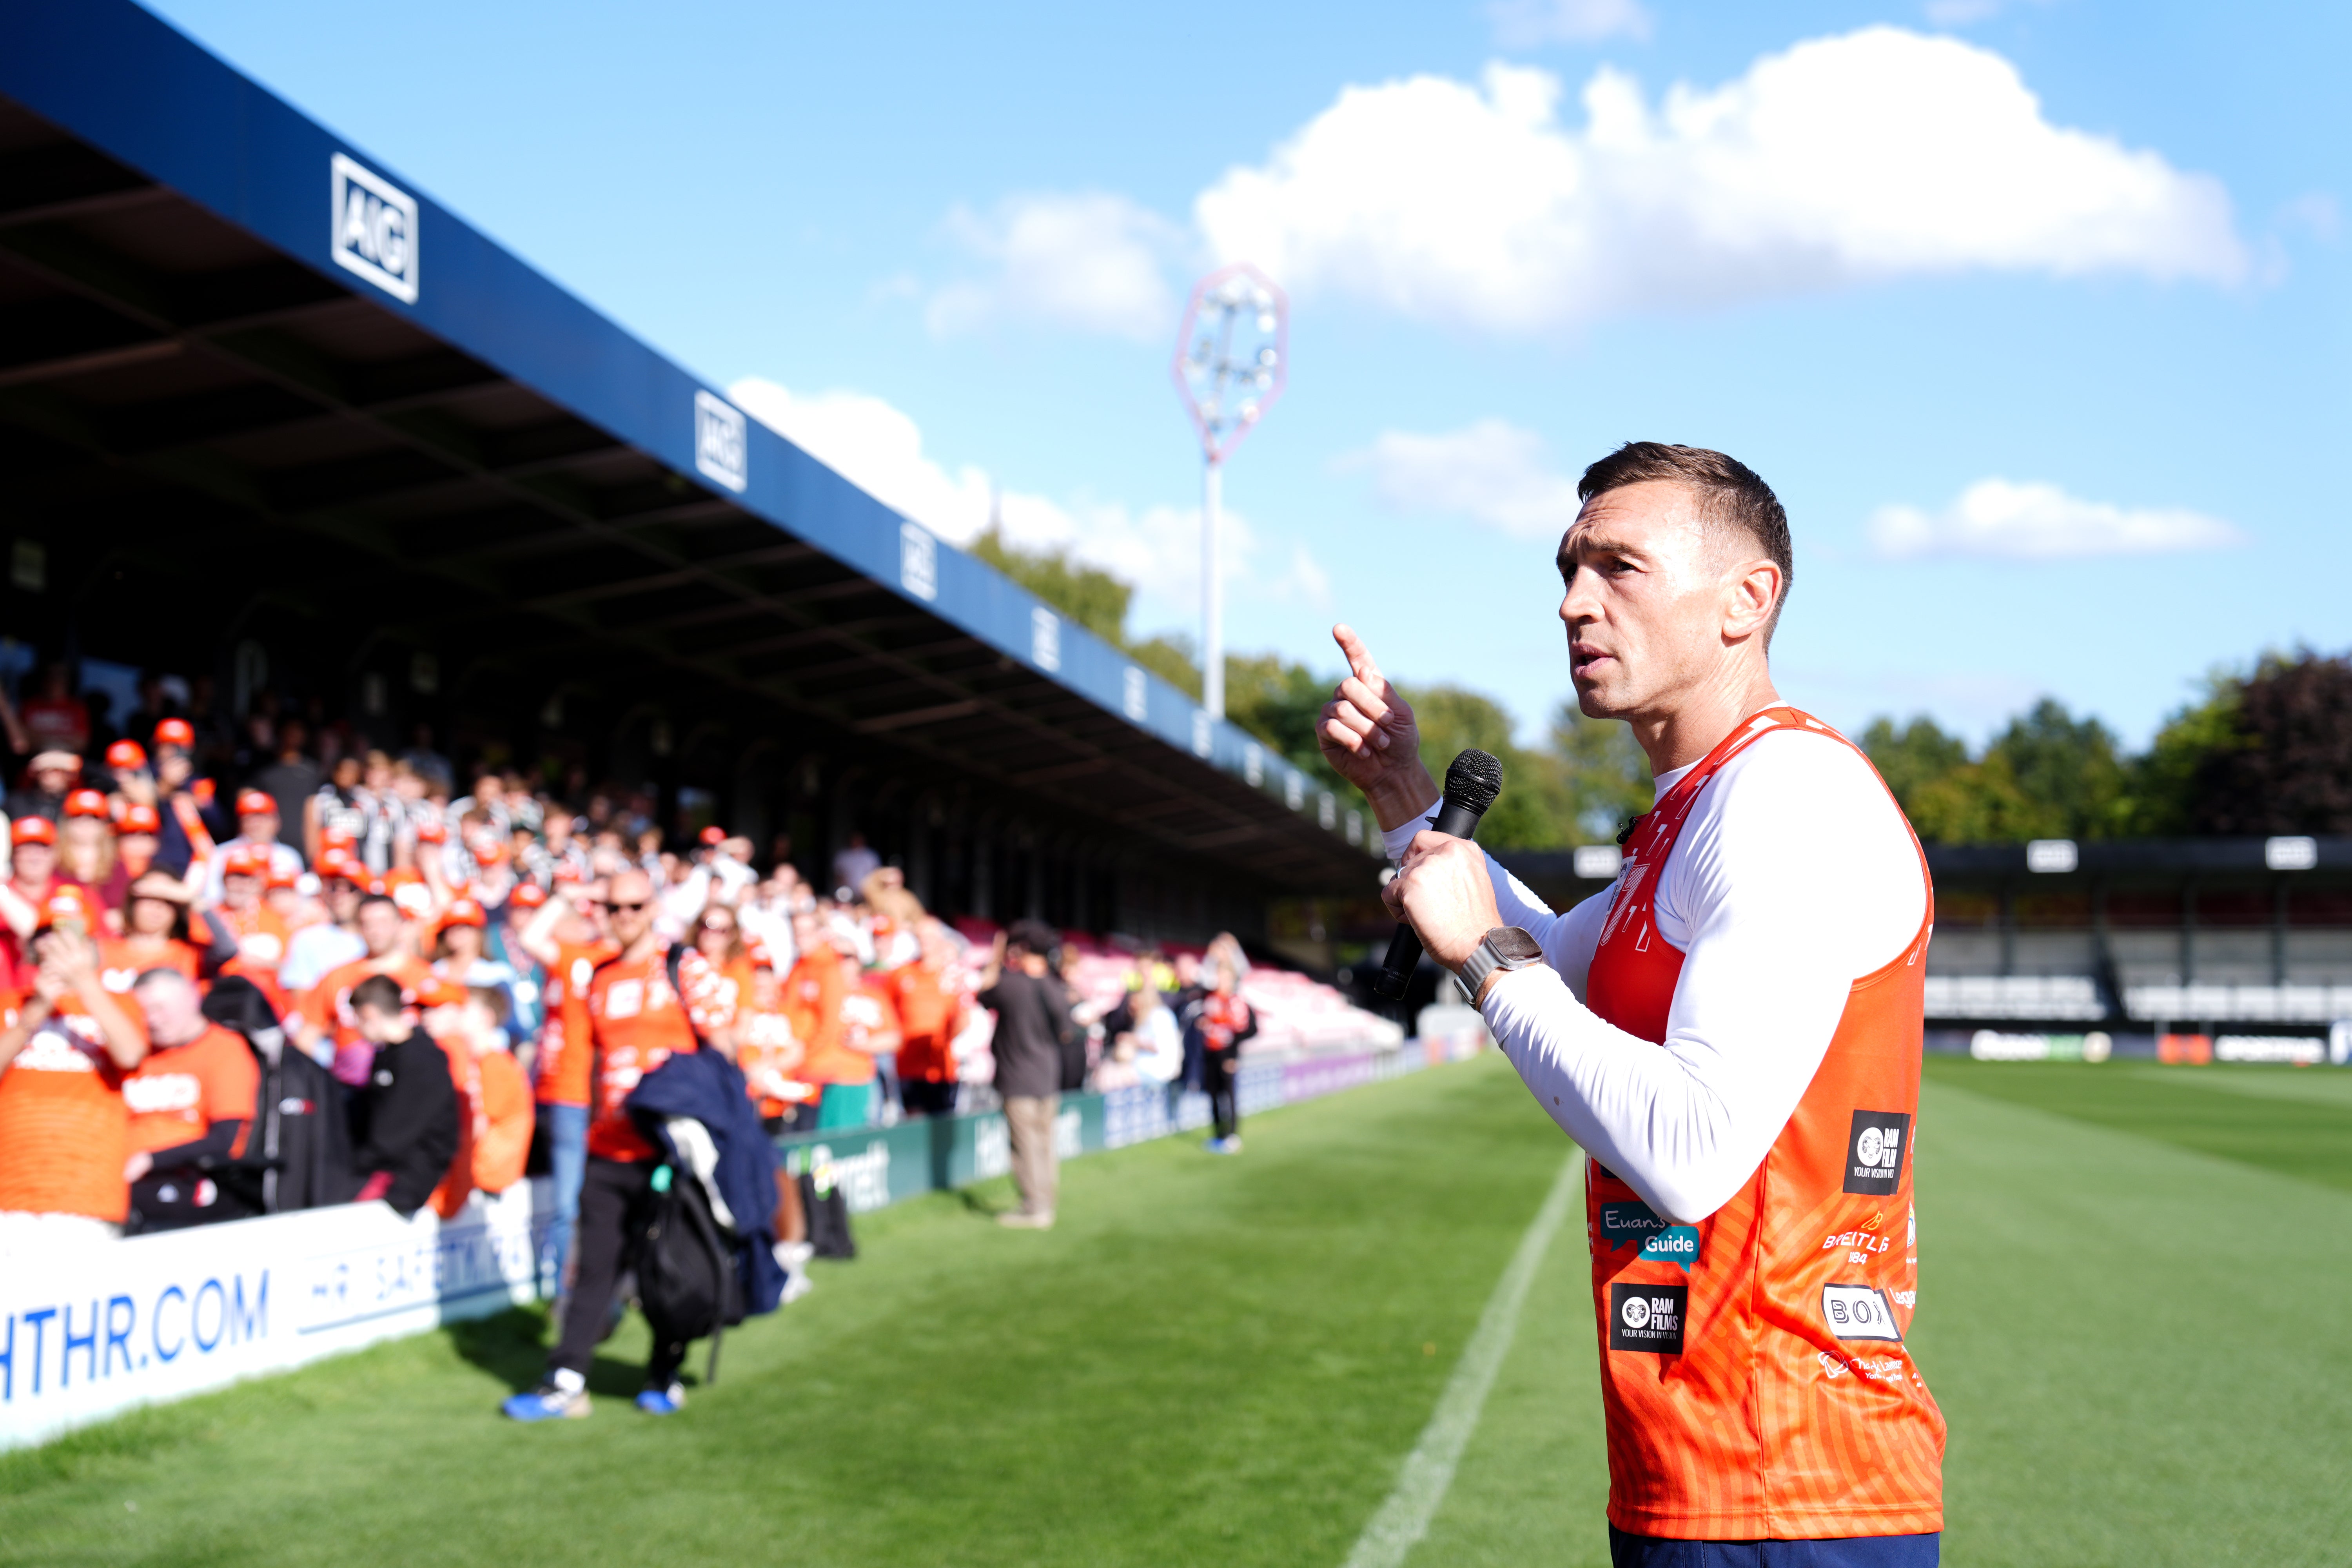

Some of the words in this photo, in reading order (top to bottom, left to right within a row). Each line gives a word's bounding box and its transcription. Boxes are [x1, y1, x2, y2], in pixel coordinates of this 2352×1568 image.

[343, 186, 408, 275] AIG
[1883, 1128, 1900, 1148] RAM
[1881, 1148, 1897, 1168] FILM
[1854, 1166, 1871, 1178] YOUR
[1605, 1210, 1666, 1229] Euan's
[1645, 1235, 1694, 1252] Guide
[1651, 1297, 1674, 1314] RAM
[1651, 1314, 1679, 1331] FILMS
[1621, 1328, 1637, 1338] YOUR
[1638, 1330, 1656, 1339] VISION
[1657, 1331, 1662, 1339] IN
[1663, 1331, 1677, 1340] VISION
